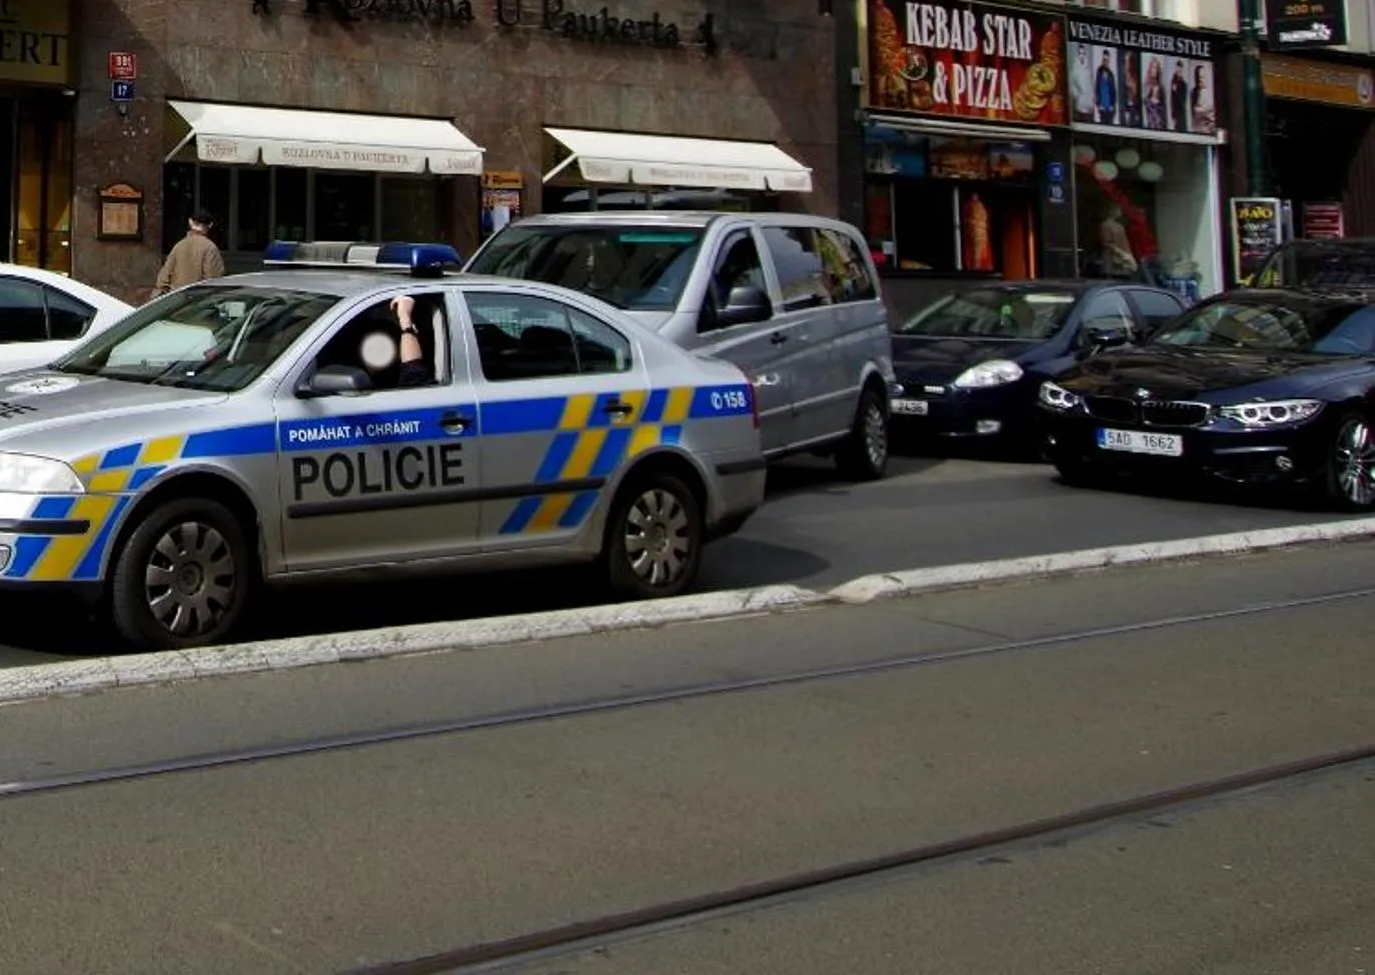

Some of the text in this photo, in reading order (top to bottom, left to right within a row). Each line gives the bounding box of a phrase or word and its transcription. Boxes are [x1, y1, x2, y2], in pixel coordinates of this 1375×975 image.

[906, 1, 1033, 60] KEBAB STAR
[1069, 21, 1212, 57] VENEZIA LEATHER STYLE
[933, 61, 1013, 111] & PIZZA
[288, 419, 422, 443] POMÁHAT A CHRÁNIT
[1142, 433, 1175, 451] 1662
[291, 442, 466, 502] POLICIE
